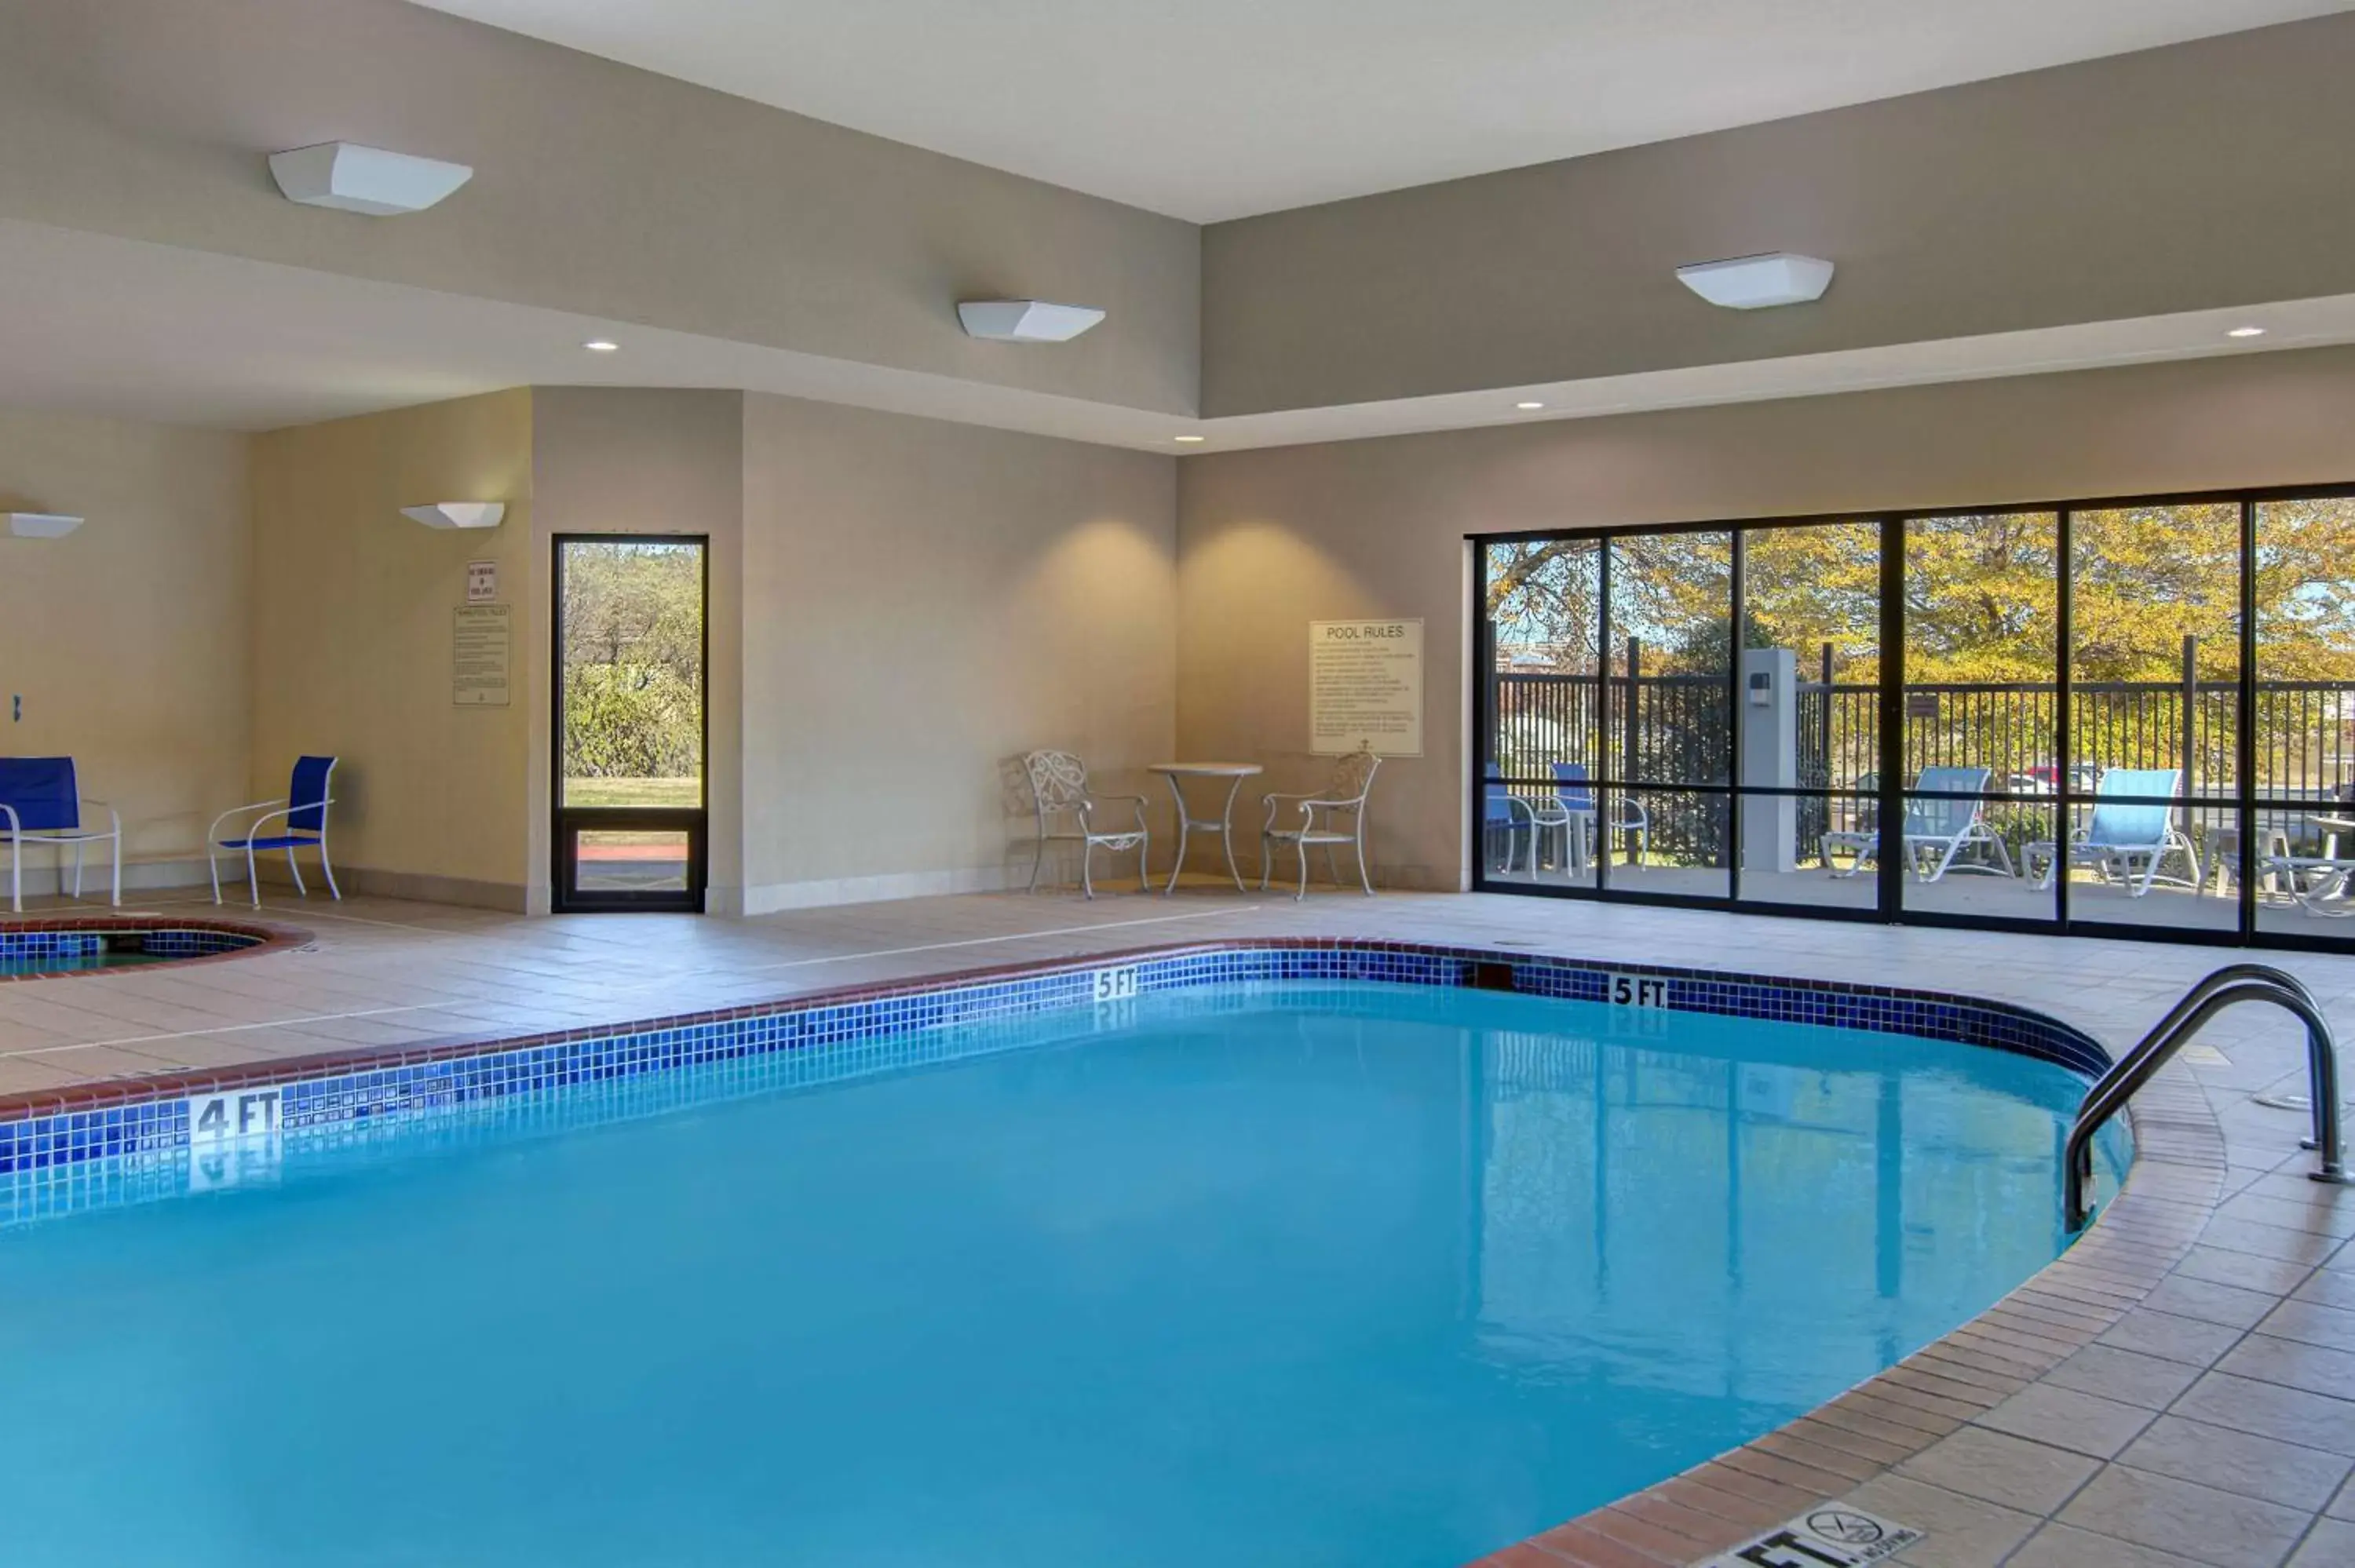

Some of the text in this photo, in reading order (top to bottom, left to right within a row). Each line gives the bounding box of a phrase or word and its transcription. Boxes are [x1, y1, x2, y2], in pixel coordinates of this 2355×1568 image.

[1327, 625, 1404, 639] POOL RULES
[1099, 968, 1135, 998] 5 FT
[1615, 977, 1631, 1005] 5
[198, 1091, 279, 1140] 4 FT
